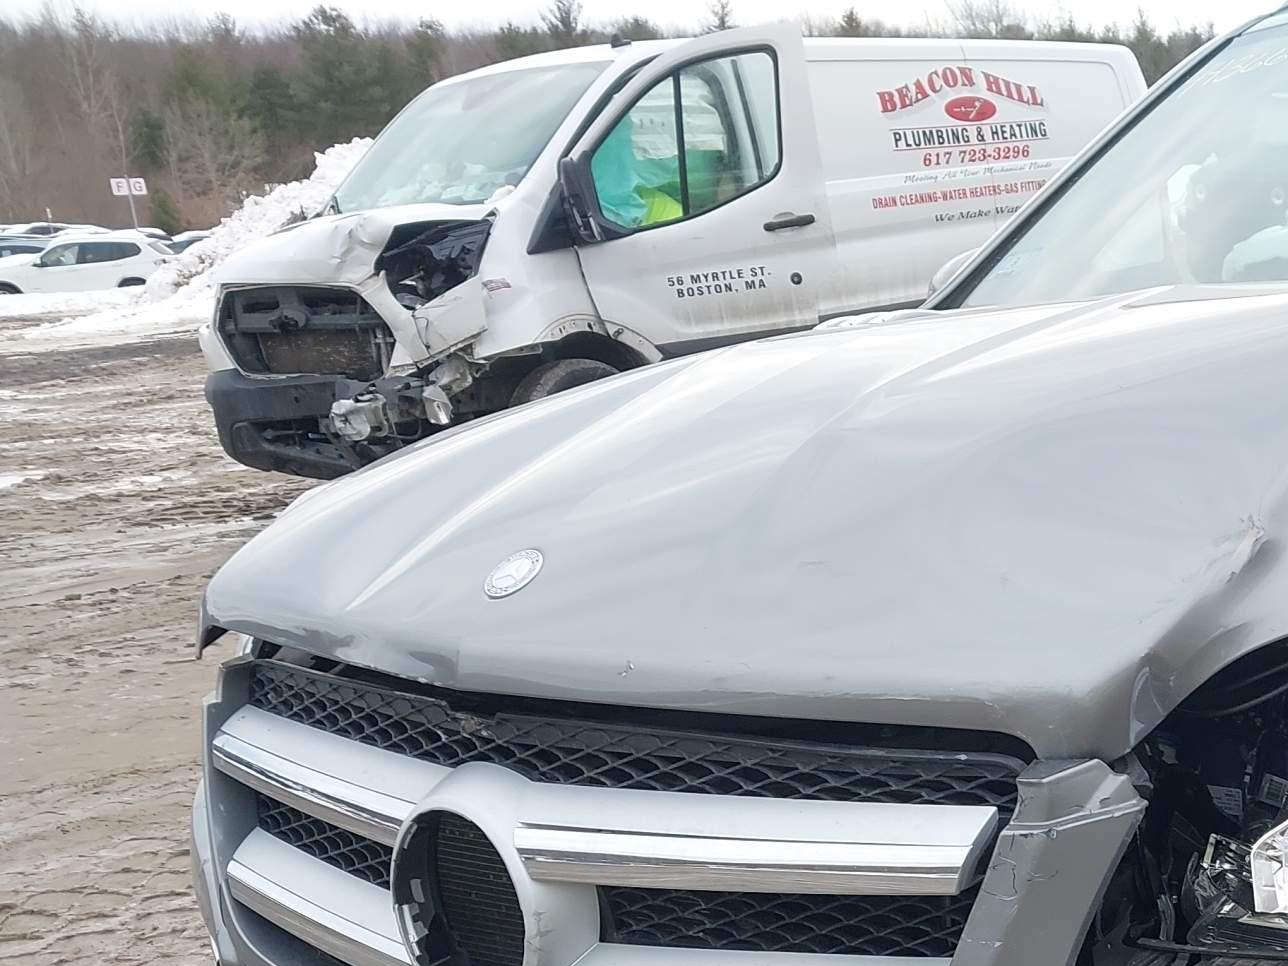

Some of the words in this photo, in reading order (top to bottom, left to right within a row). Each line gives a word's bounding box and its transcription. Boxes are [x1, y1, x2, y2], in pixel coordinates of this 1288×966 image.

[877, 66, 976, 113] BEACON
[982, 71, 1045, 107] HILL
[893, 126, 970, 149] PLUMBING
[976, 126, 986, 142] &
[991, 121, 1048, 141] HEATING
[923, 151, 953, 167] 617
[960, 145, 1030, 164] 723-3296
[115, 181, 124, 192] F
[133, 181, 143, 192] G
[872, 196, 898, 209] DRAIN
[899, 189, 968, 207] CLEANING-WATER
[970, 183, 1018, 199] HEATERS-GAS
[935, 213, 954, 223] We
[958, 210, 991, 221] Make
[667, 276, 684, 287] 56
[690, 269, 745, 285] MYRTLE
[750, 266, 772, 278] ST.
[676, 283, 739, 298] BOSTON,
[745, 279, 766, 290] MA
